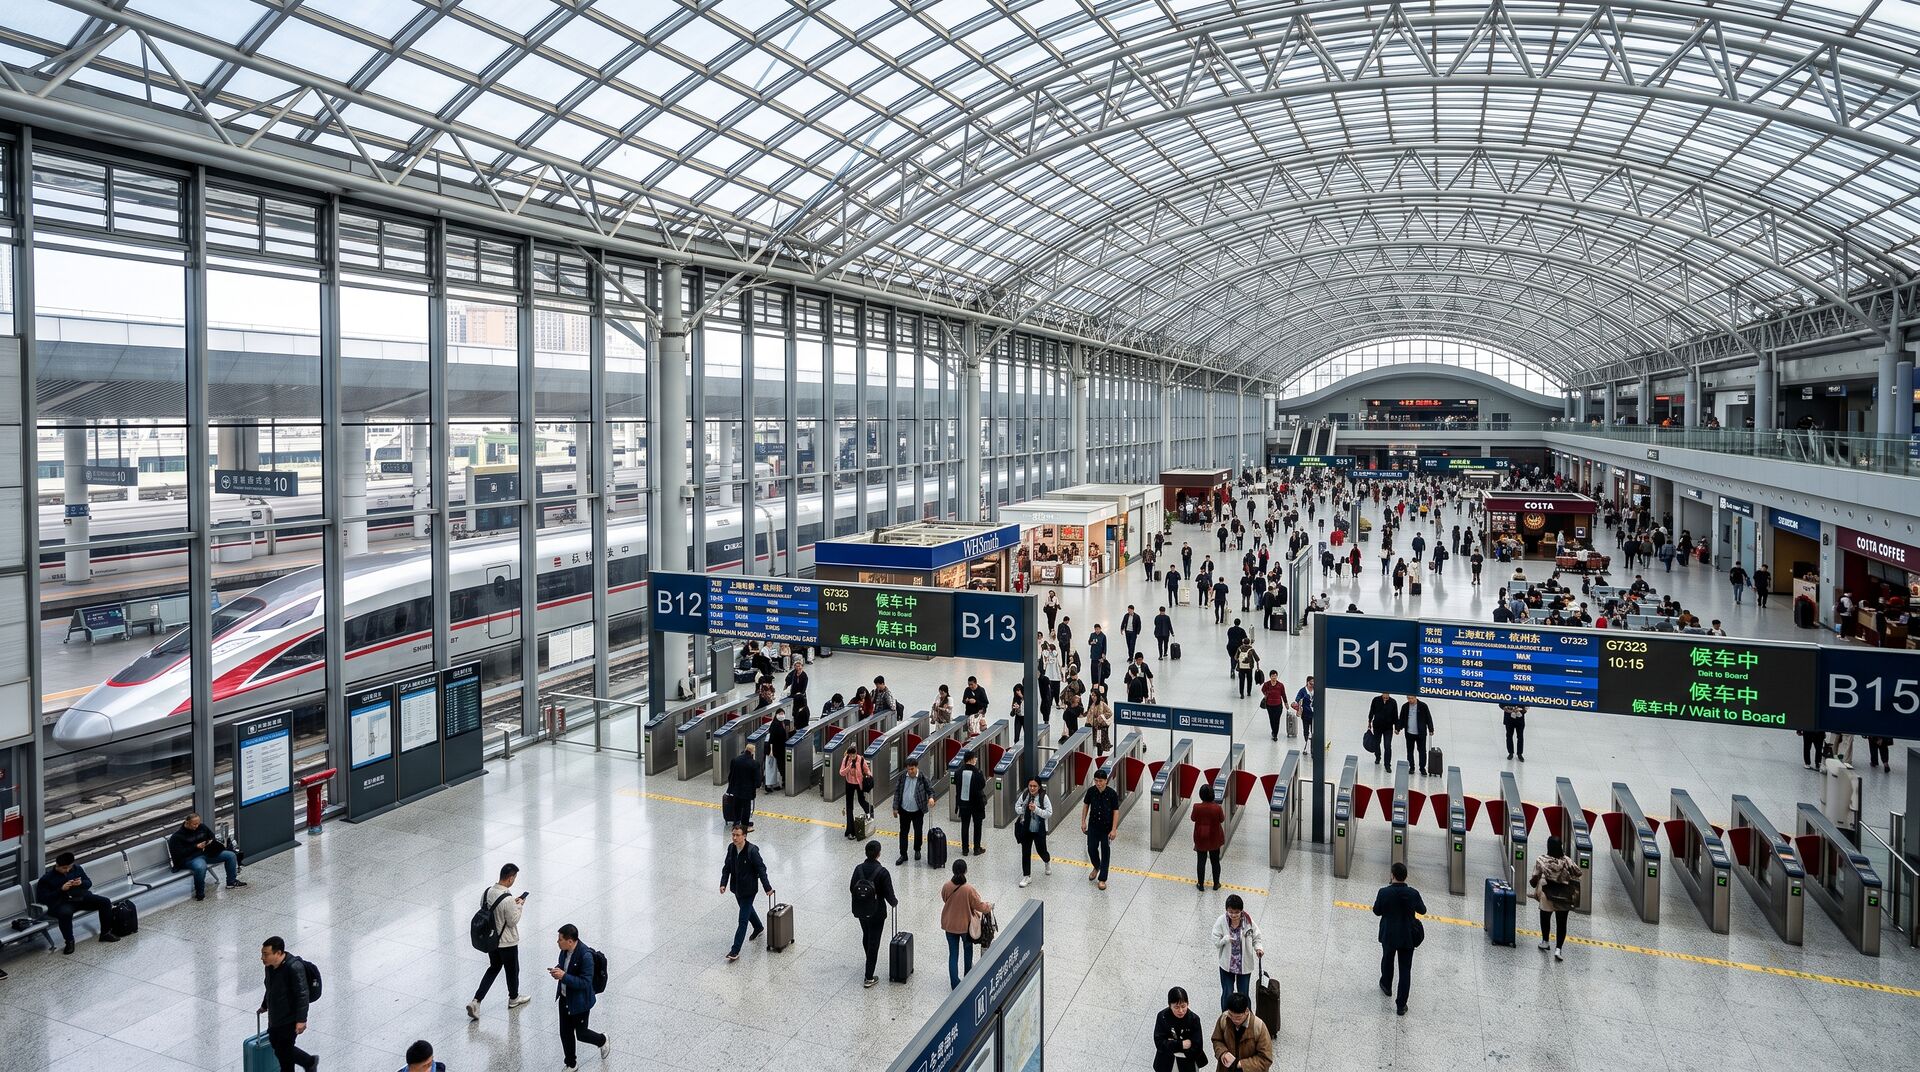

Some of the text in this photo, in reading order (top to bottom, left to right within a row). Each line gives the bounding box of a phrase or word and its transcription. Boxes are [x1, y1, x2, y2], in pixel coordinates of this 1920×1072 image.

[117, 471, 126, 482] 10
[273, 477, 288, 492] 10
[962, 532, 1000, 558] WHSmith
[1878, 543, 1905, 563] COFFEE
[657, 589, 702, 617] B12
[823, 588, 849, 599] G7323
[875, 593, 918, 610] 候车中
[825, 602, 848, 613] 10:15
[875, 619, 918, 638] 候车中
[962, 611, 1017, 642] B13
[840, 634, 937, 652] 候车中 / Wait to Board
[1560, 636, 1588, 646] G7323
[1606, 640, 1648, 653] G7323
[1338, 637, 1409, 673] B15
[1608, 656, 1644, 670] 10:15
[1689, 646, 1759, 670] 候车中
[1724, 672, 1749, 680] Board
[1420, 686, 1463, 697] SHANGHAI
[1518, 694, 1569, 706] HANGZHOU
[1570, 699, 1595, 708] EAST
[1689, 682, 1758, 706] 候车中
[1828, 673, 1920, 715] B15
[1631, 698, 1786, 725] 候车中 / Wait to Board
